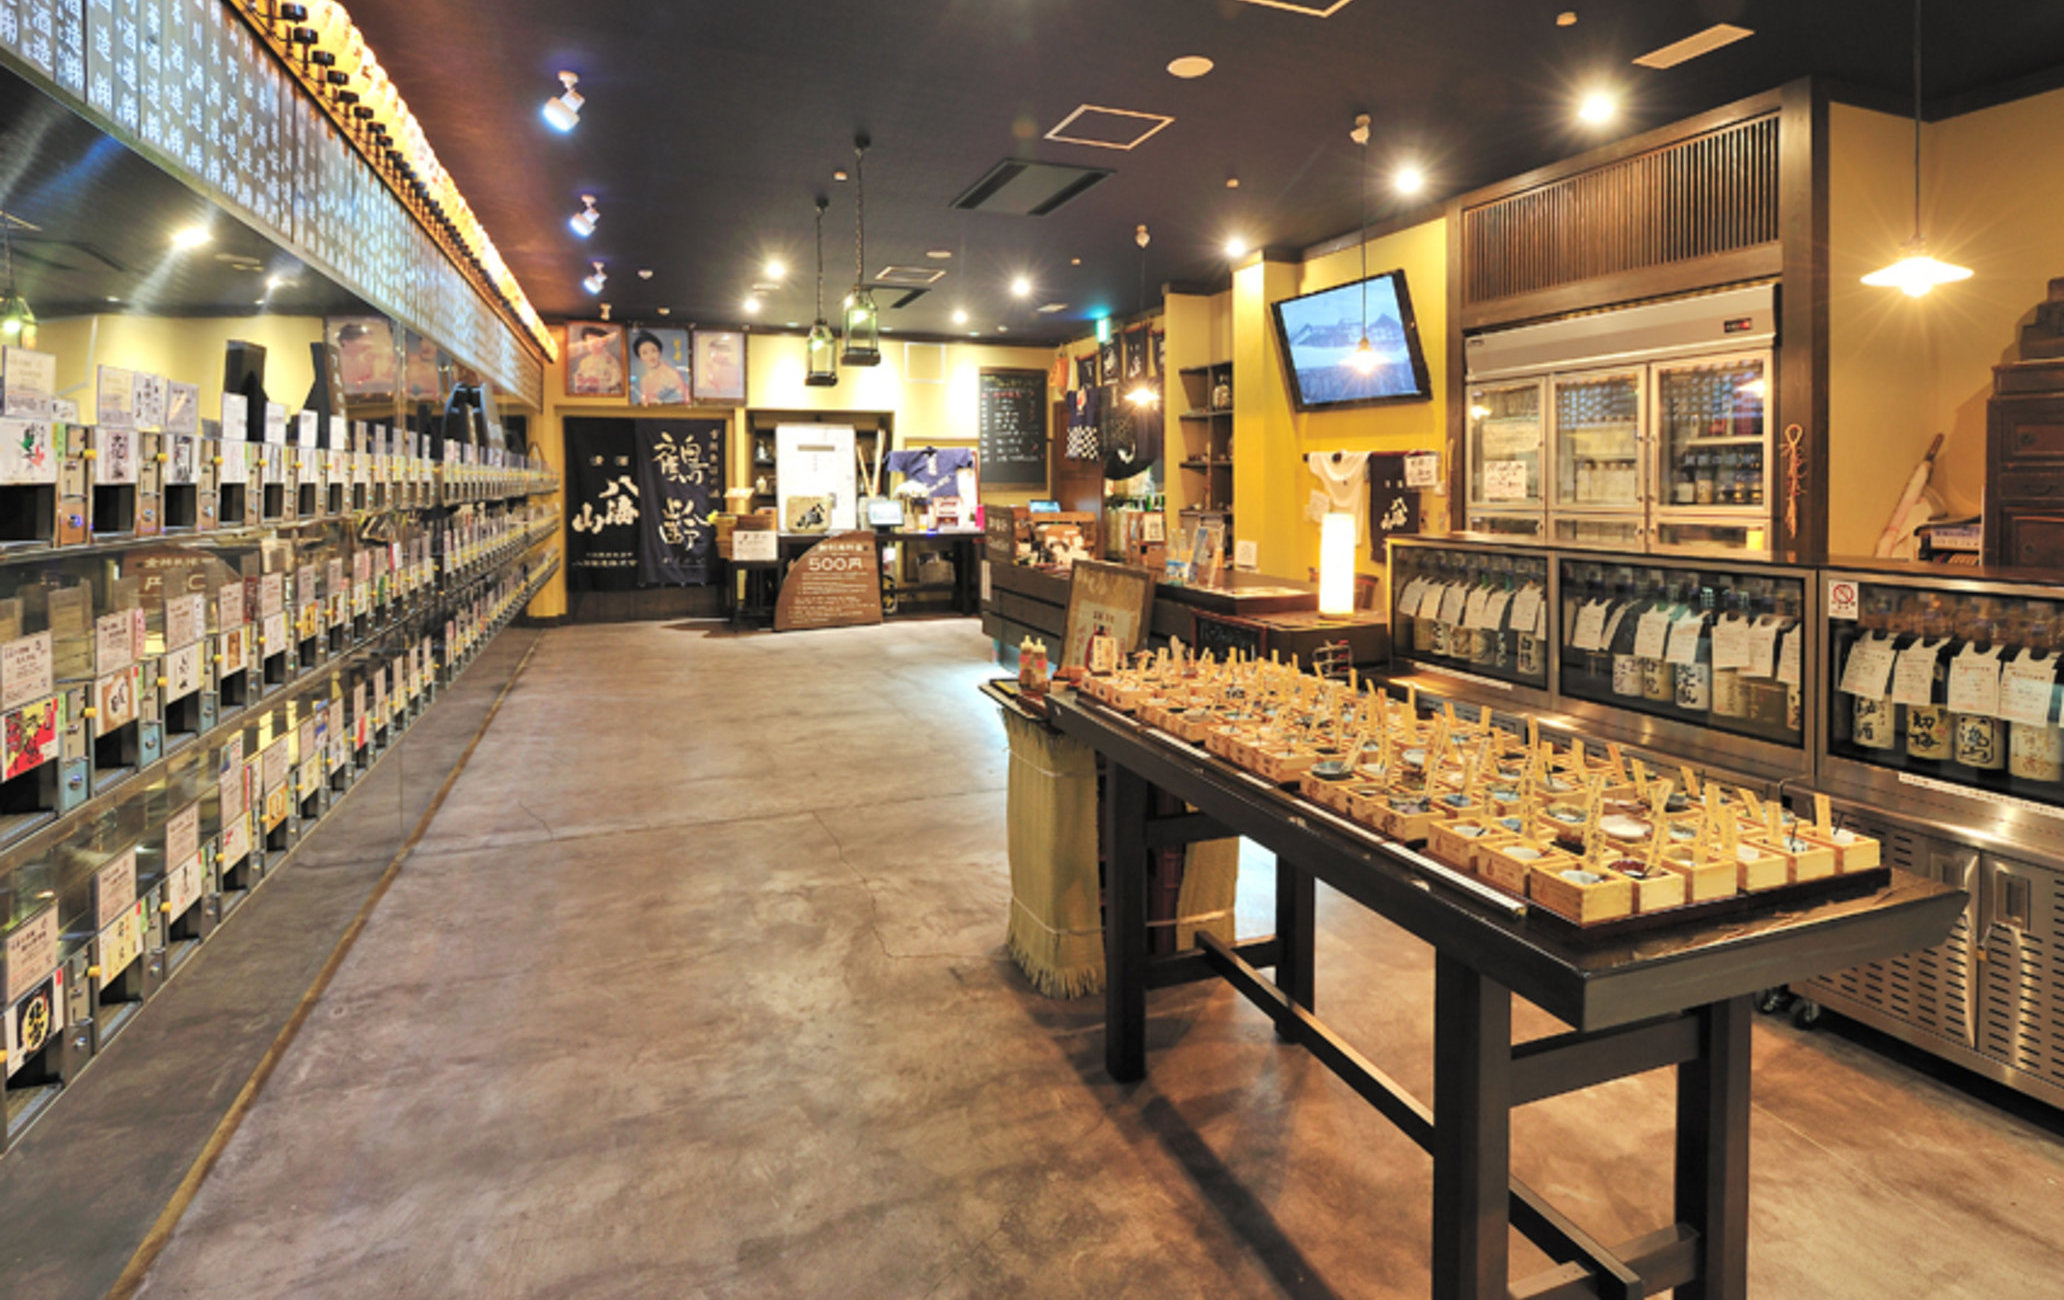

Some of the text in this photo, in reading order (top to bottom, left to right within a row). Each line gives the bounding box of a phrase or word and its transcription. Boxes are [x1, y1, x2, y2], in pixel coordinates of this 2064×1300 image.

[572, 475, 640, 535] 八海山
[652, 431, 711, 551] 鶴齢
[808, 557, 863, 572] 500円
